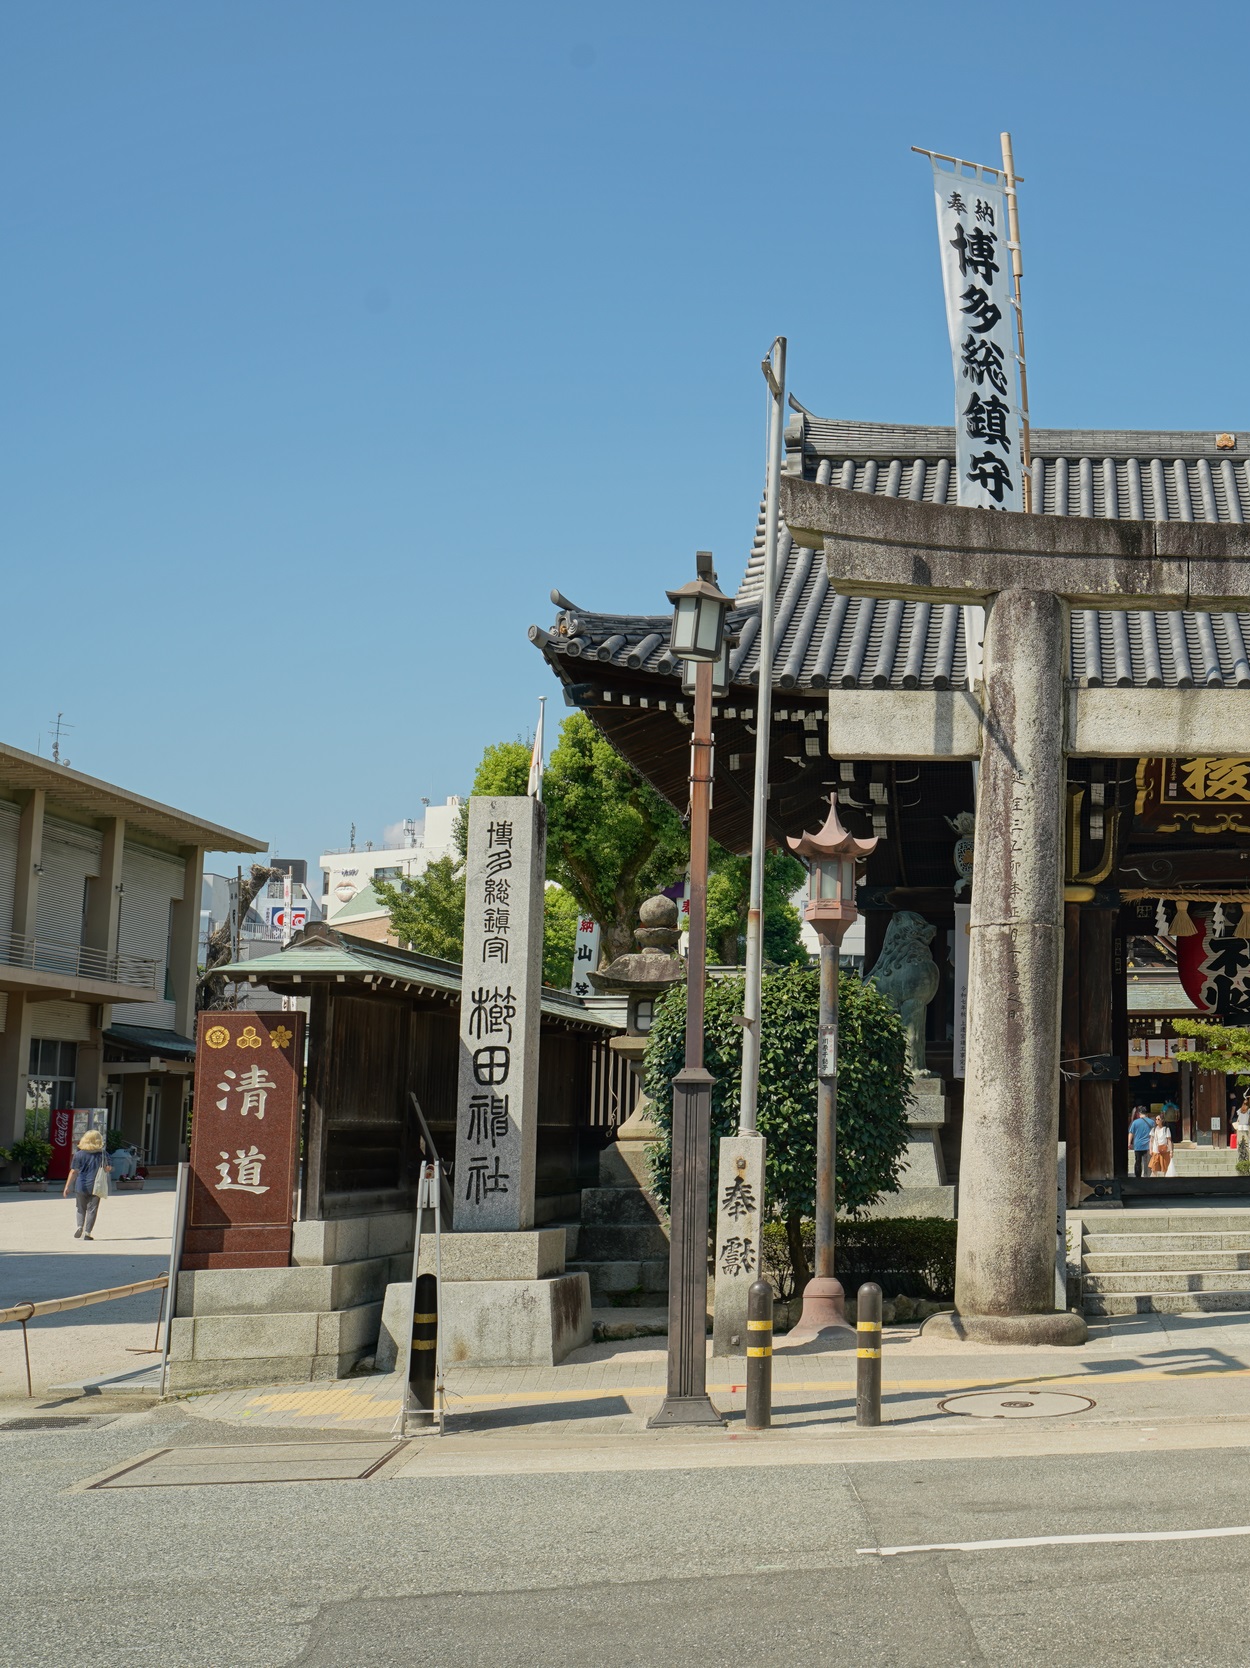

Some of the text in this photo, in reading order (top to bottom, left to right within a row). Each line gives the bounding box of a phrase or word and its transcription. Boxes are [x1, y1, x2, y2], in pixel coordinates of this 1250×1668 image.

[946, 191, 995, 227] 奉納
[950, 222, 1013, 509] 博多総鎮守
[55, 1112, 69, 1147] Coca-Cola
[215, 1064, 277, 1195] 清道
[465, 986, 517, 1205] 櫛田神社
